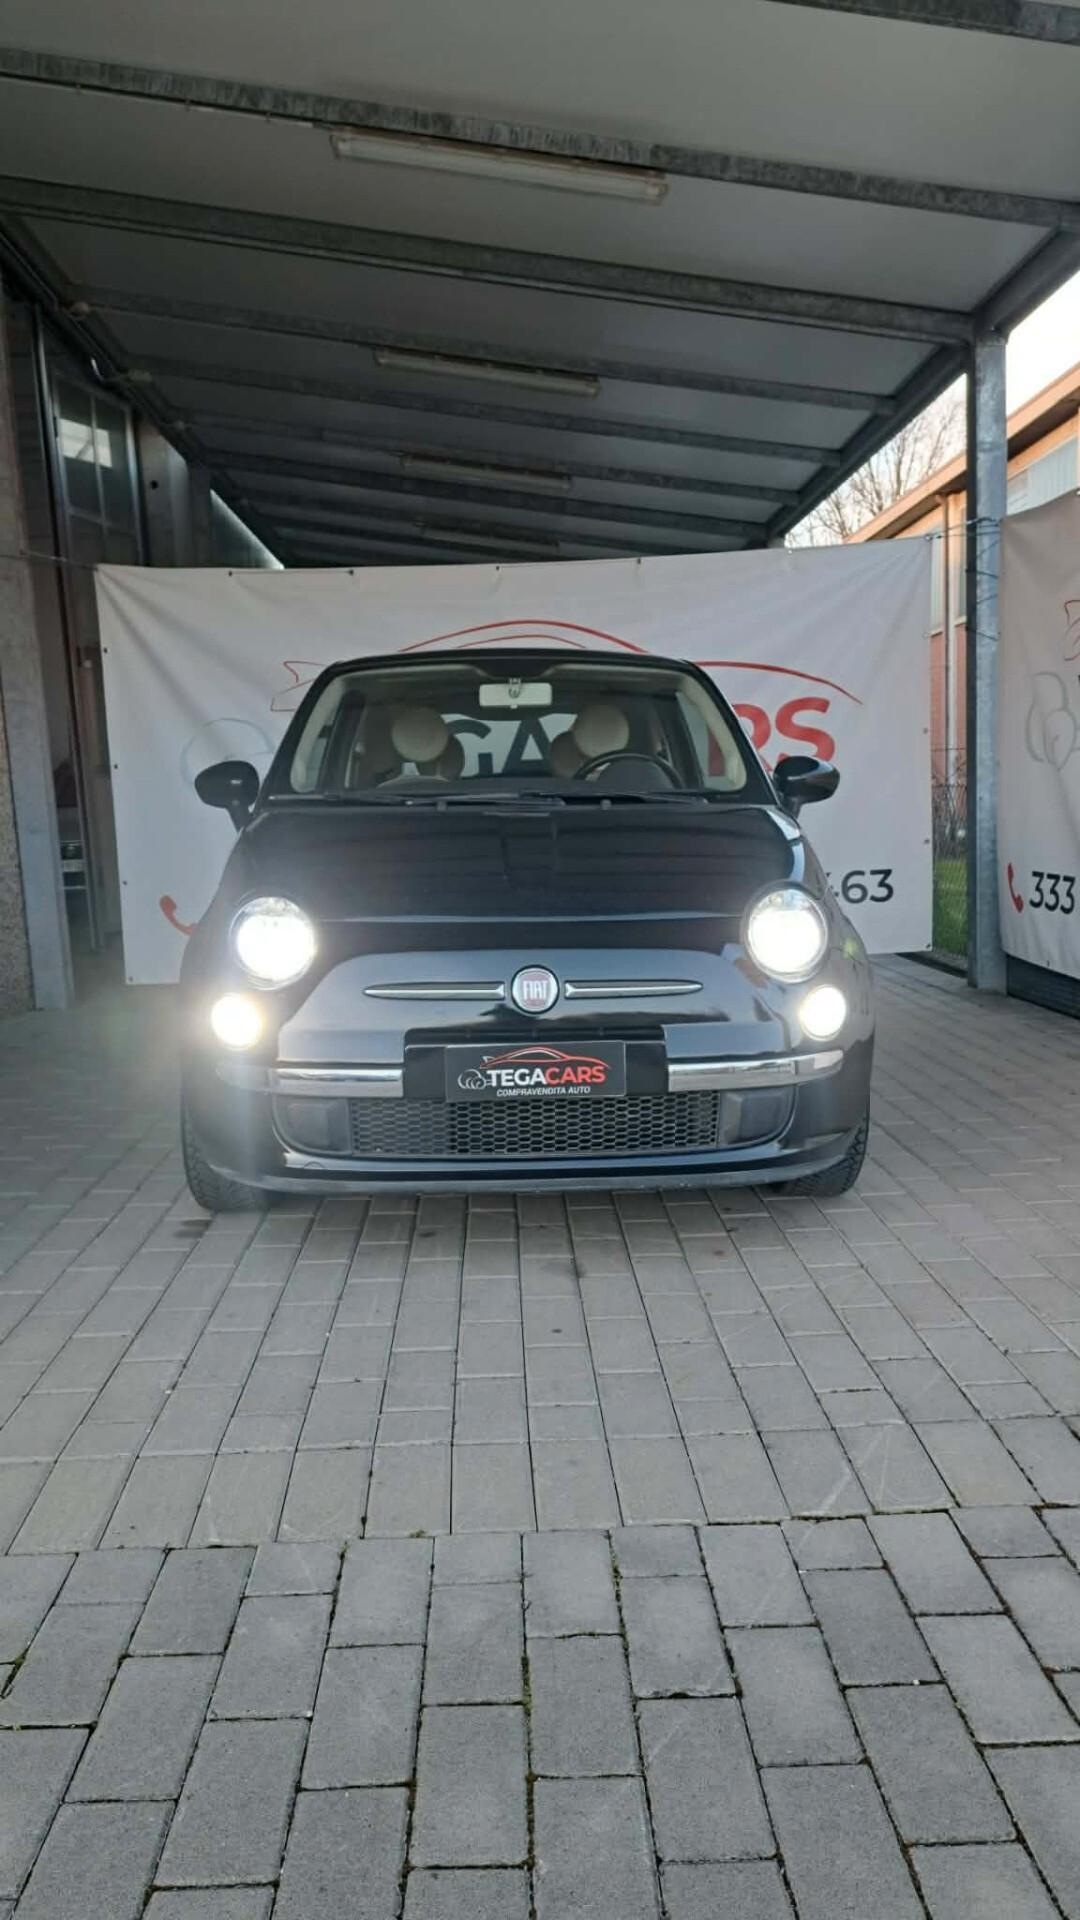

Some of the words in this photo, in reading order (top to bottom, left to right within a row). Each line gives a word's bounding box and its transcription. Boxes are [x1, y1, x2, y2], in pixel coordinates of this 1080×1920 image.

[1029, 870, 1076, 915] 333
[523, 980, 548, 1000] FIAT
[486, 1066, 607, 1087] TEGACARS
[496, 1086, 566, 1097] COMPRAVENDITA
[568, 1085, 591, 1094] AUTO
